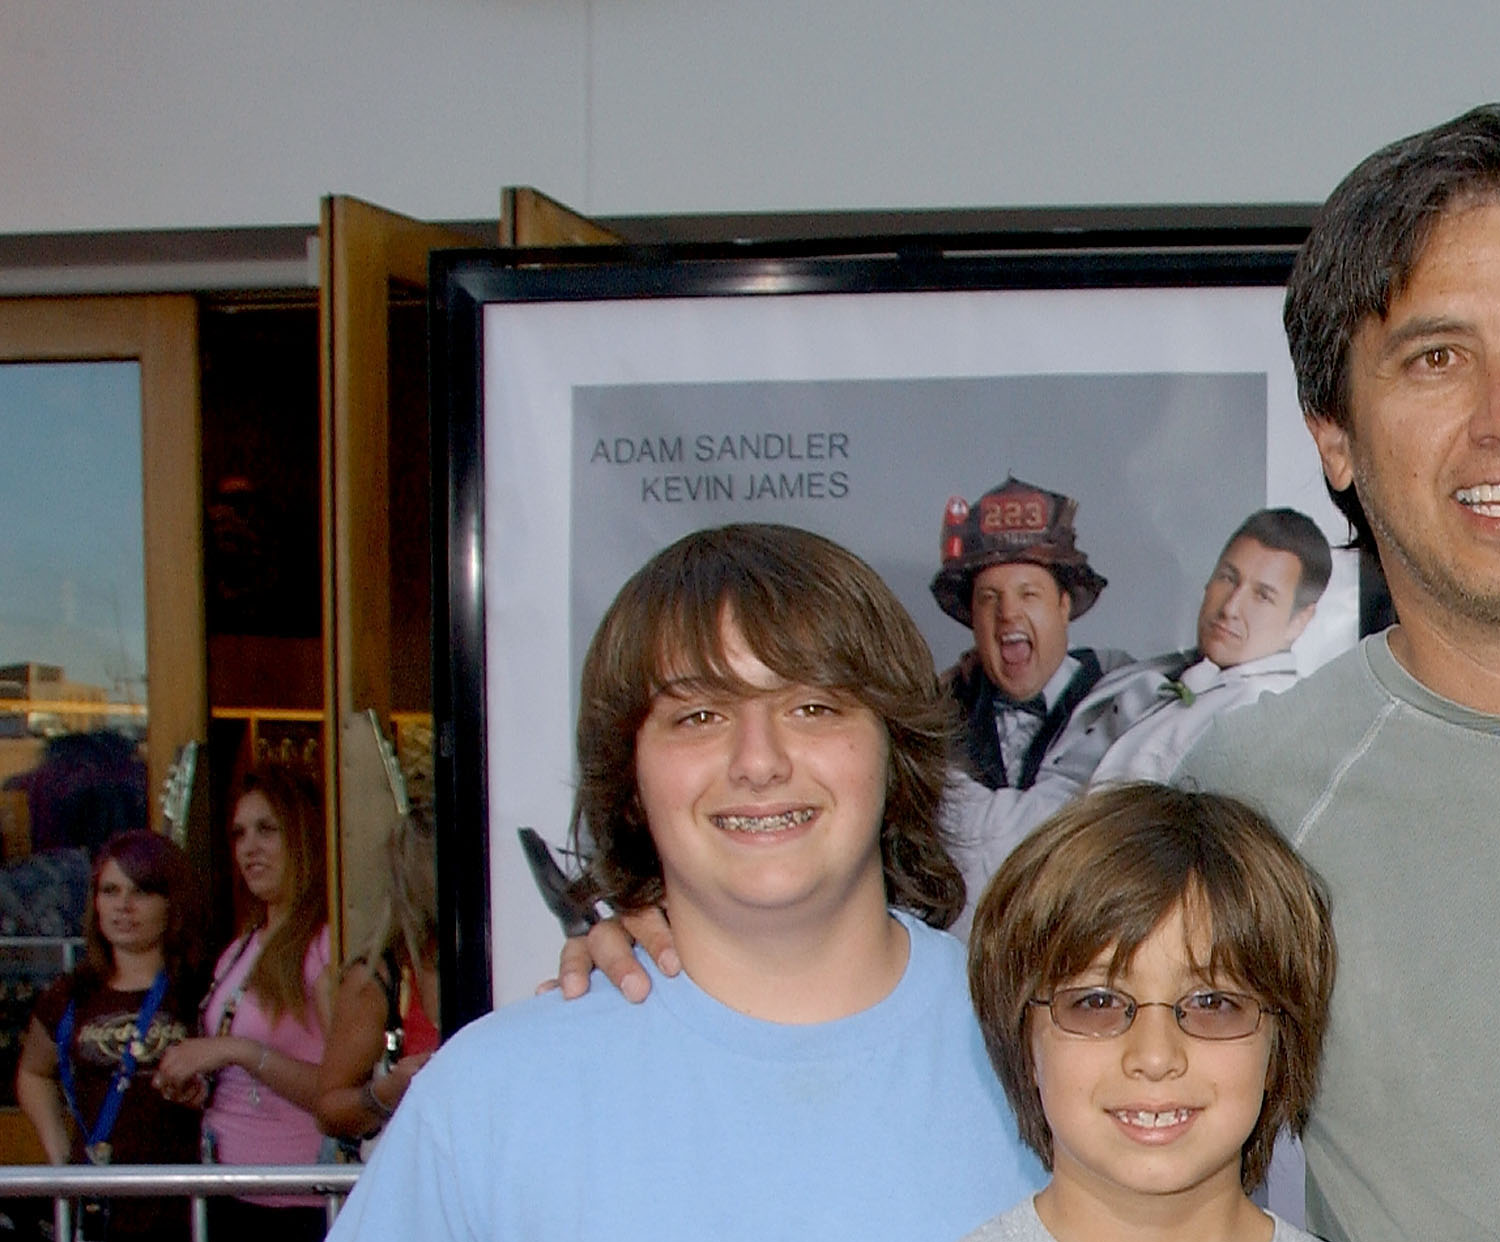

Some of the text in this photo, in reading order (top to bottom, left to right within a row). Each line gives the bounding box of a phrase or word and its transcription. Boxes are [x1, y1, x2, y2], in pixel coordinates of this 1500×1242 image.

[591, 433, 849, 464] ADAM SANDLER
[641, 471, 849, 501] KEVIN JAMES
[984, 499, 1042, 526] 223
